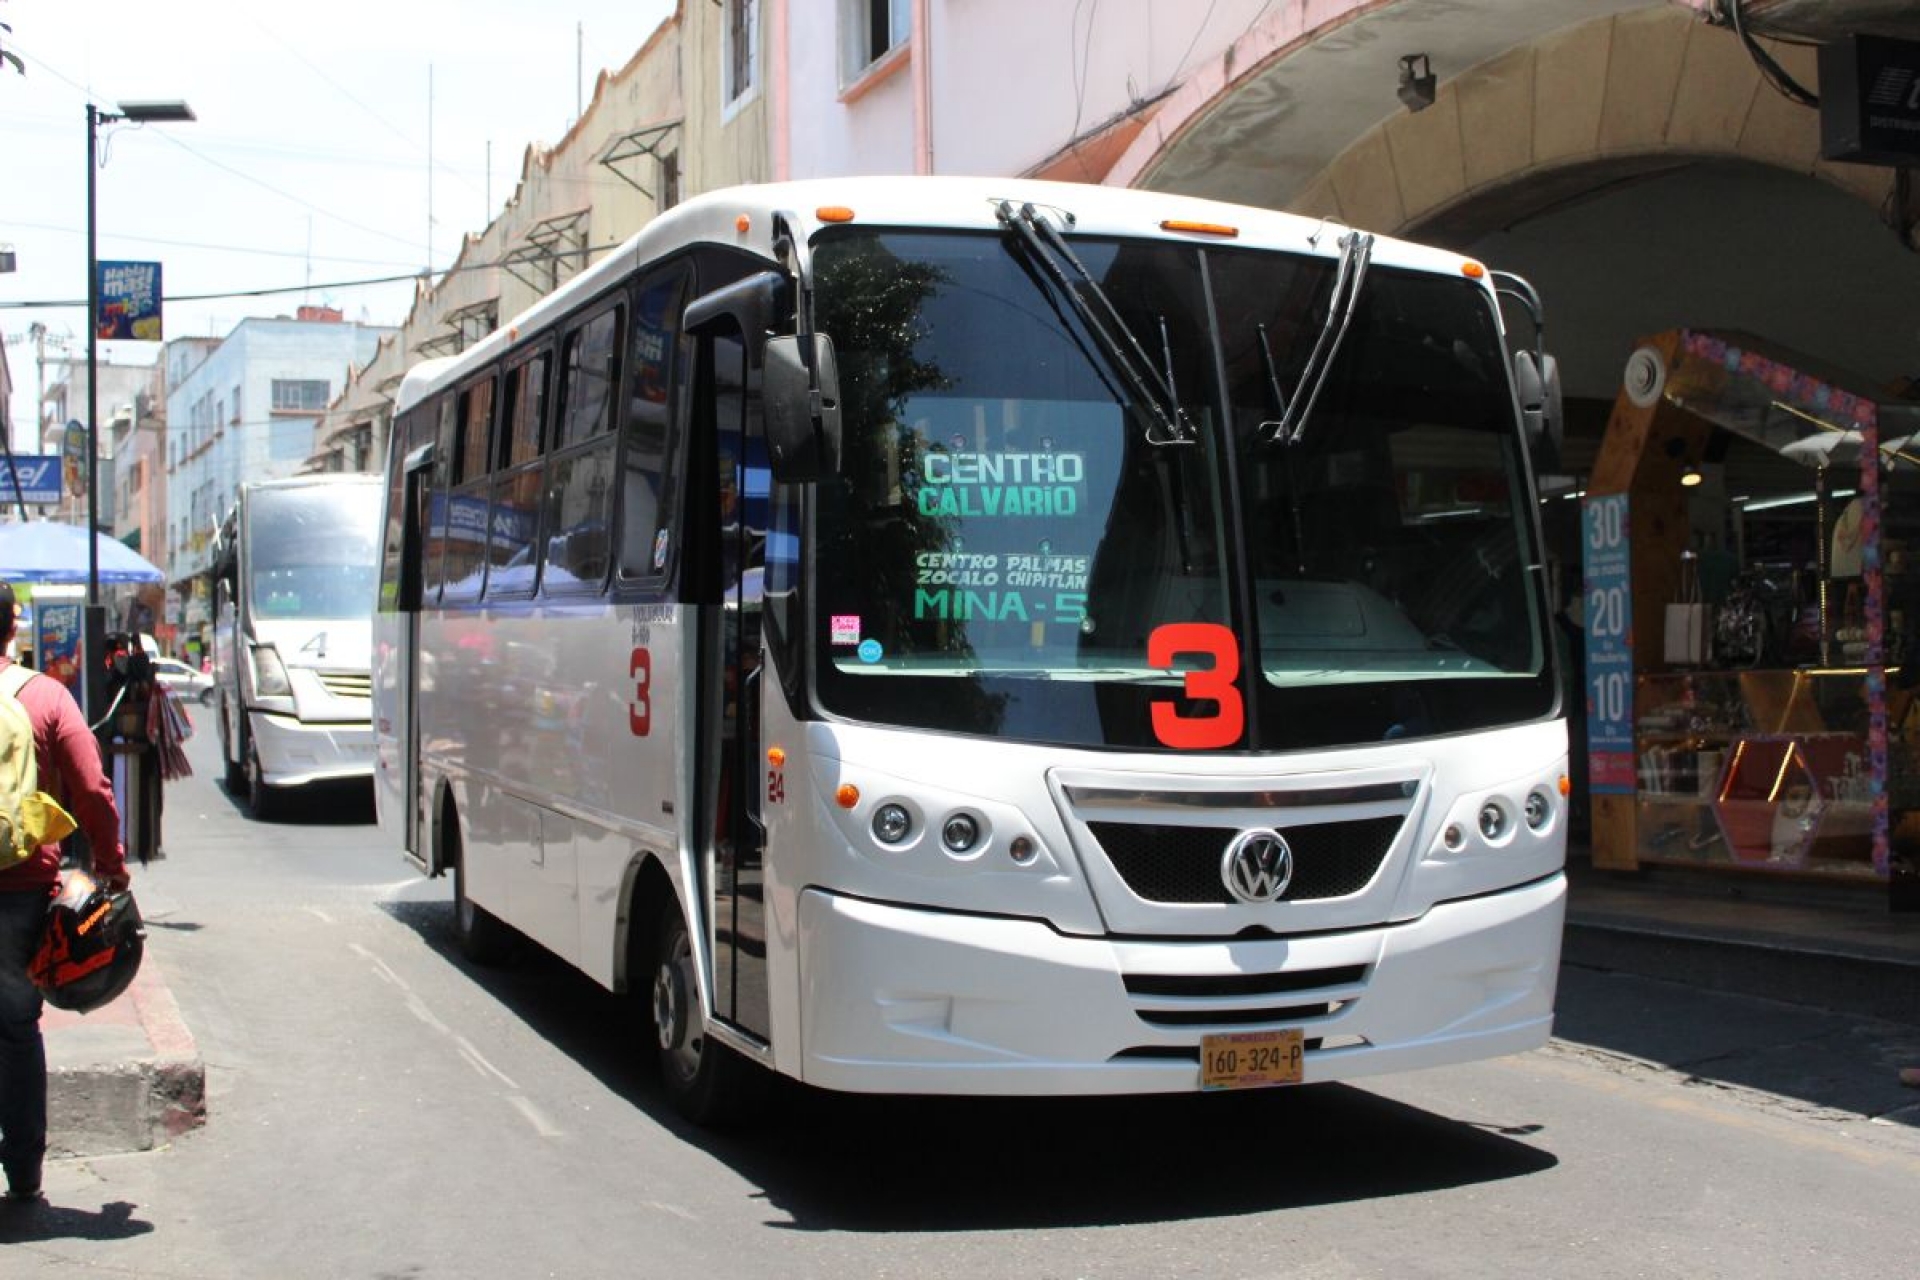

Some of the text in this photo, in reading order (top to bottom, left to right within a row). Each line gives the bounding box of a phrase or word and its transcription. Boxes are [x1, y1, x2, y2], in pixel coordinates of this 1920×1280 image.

[924, 453, 1083, 484] CENTRO
[916, 552, 1087, 574] CENTRO PALMAS
[916, 570, 999, 586] ZOCALO
[914, 588, 1028, 621] MINA
[629, 647, 651, 737] 3
[1147, 623, 1243, 748] 3
[767, 771, 785, 804] 24
[1208, 1045, 1301, 1075] 160-324-P
